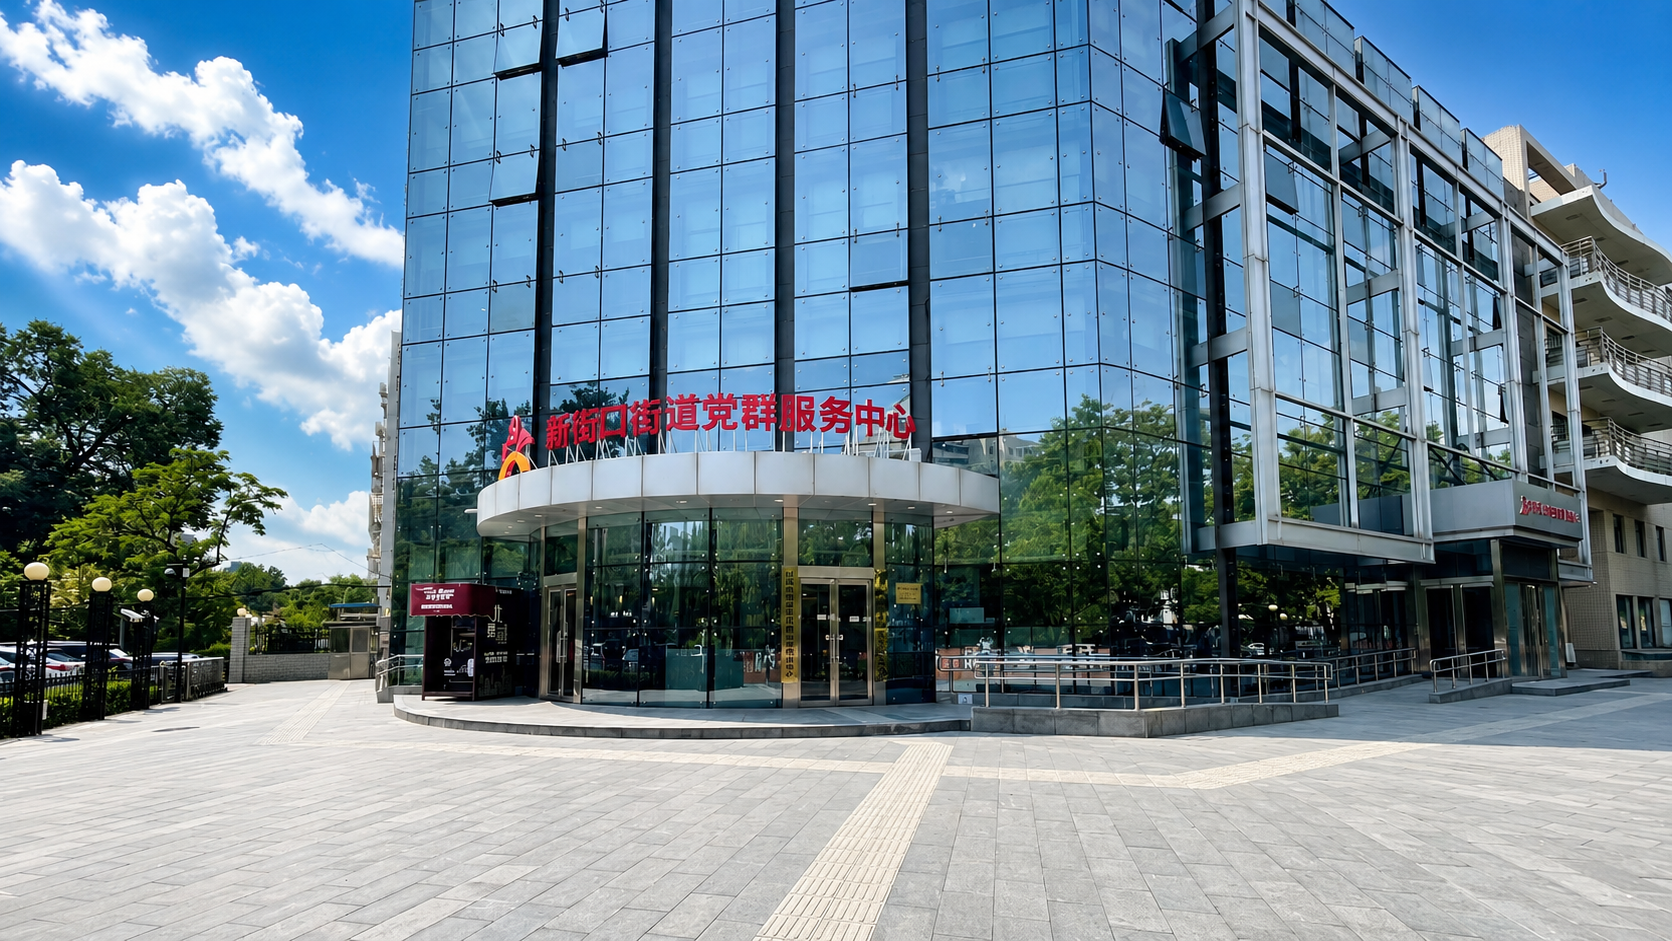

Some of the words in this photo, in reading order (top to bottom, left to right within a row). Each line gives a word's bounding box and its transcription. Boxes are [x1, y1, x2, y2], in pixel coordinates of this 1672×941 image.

[545, 393, 917, 450] 新街口街道党群服务中心
